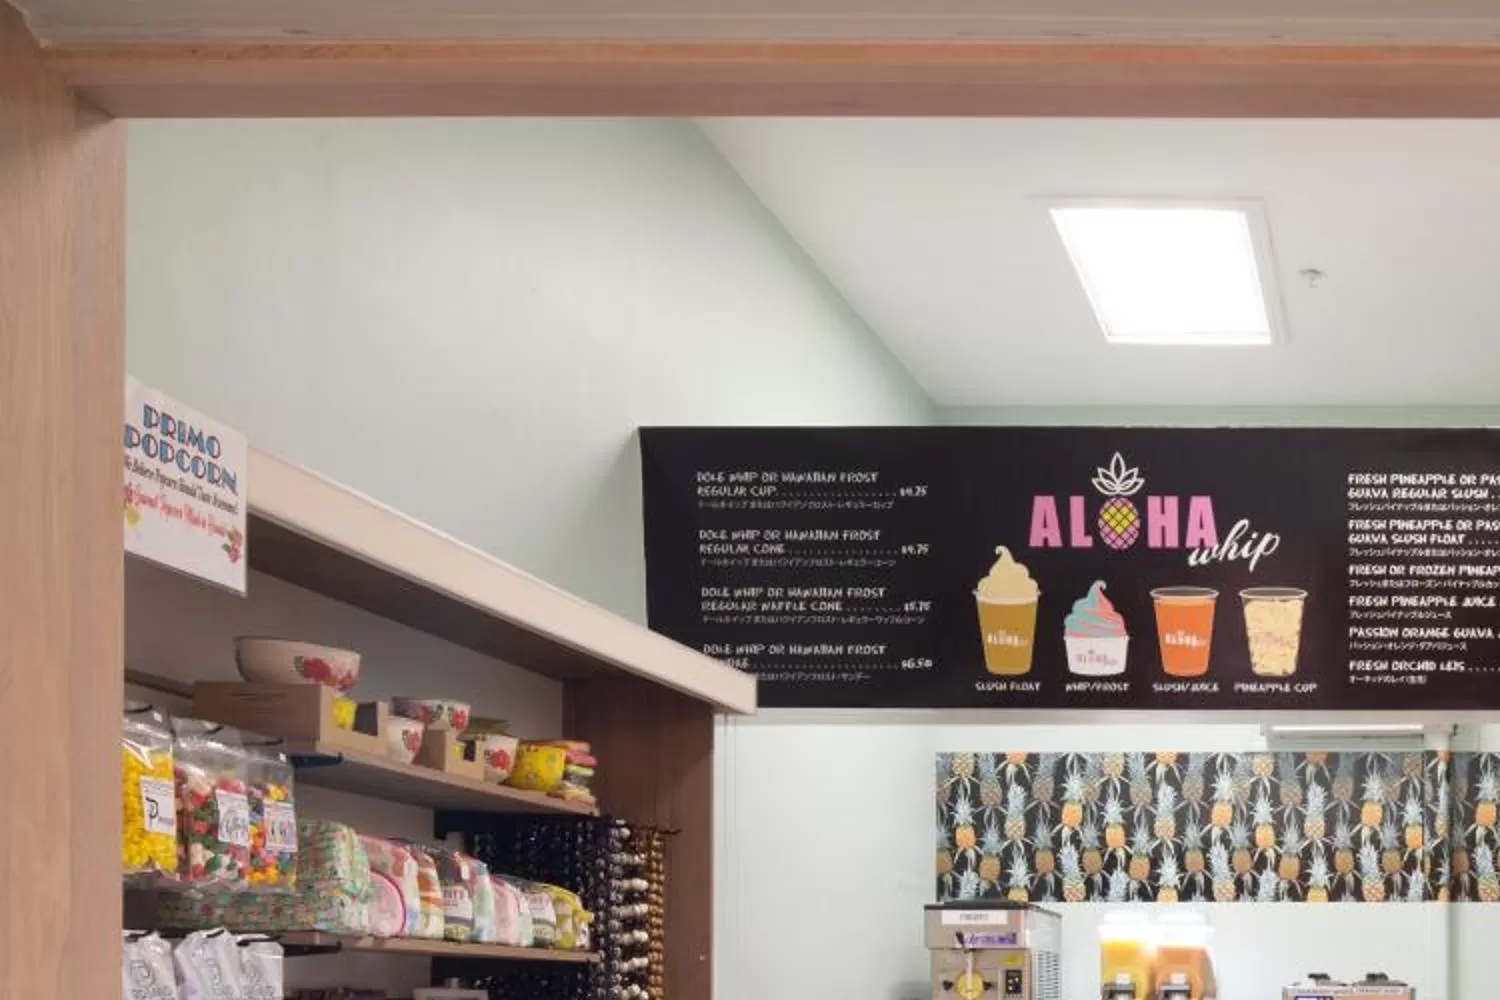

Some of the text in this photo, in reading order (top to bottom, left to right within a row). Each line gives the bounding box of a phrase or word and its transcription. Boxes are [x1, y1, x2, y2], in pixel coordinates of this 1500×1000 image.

[143, 403, 221, 460] PRIMO
[124, 423, 240, 497] POPCORN
[1348, 473, 1387, 485] FRESH
[1389, 473, 1457, 485] PINEAPPLE
[1459, 473, 1477, 485] OR
[1347, 487, 1389, 499] GUAVA
[1391, 487, 1448, 499] REGULAR
[1451, 487, 1490, 499] SLUSH
[1029, 495, 1219, 550] ALOHA
[1348, 519, 1387, 531] FRESH
[1389, 519, 1453, 531] PINEAPPLE
[1455, 519, 1473, 531] OR
[1187, 518, 1281, 572] whip
[1347, 533, 1389, 545] GUAVA
[1391, 533, 1427, 545] SLUSH
[1429, 533, 1467, 545] FLOAT
[1349, 565, 1387, 577] FRESH
[1389, 565, 1405, 577] OR
[1409, 565, 1456, 577] FROZEN
[1349, 595, 1388, 608] FRESH
[1391, 595, 1458, 608] PINEAPPLE
[1461, 595, 1497, 608] JUICE
[1349, 627, 1399, 640] PASSION
[1401, 627, 1450, 640] ORANGE
[1453, 627, 1495, 640] GUAVA
[1349, 660, 1389, 672] FRESH
[1391, 660, 1437, 672] ORCHID
[1439, 660, 1466, 672] LEIS
